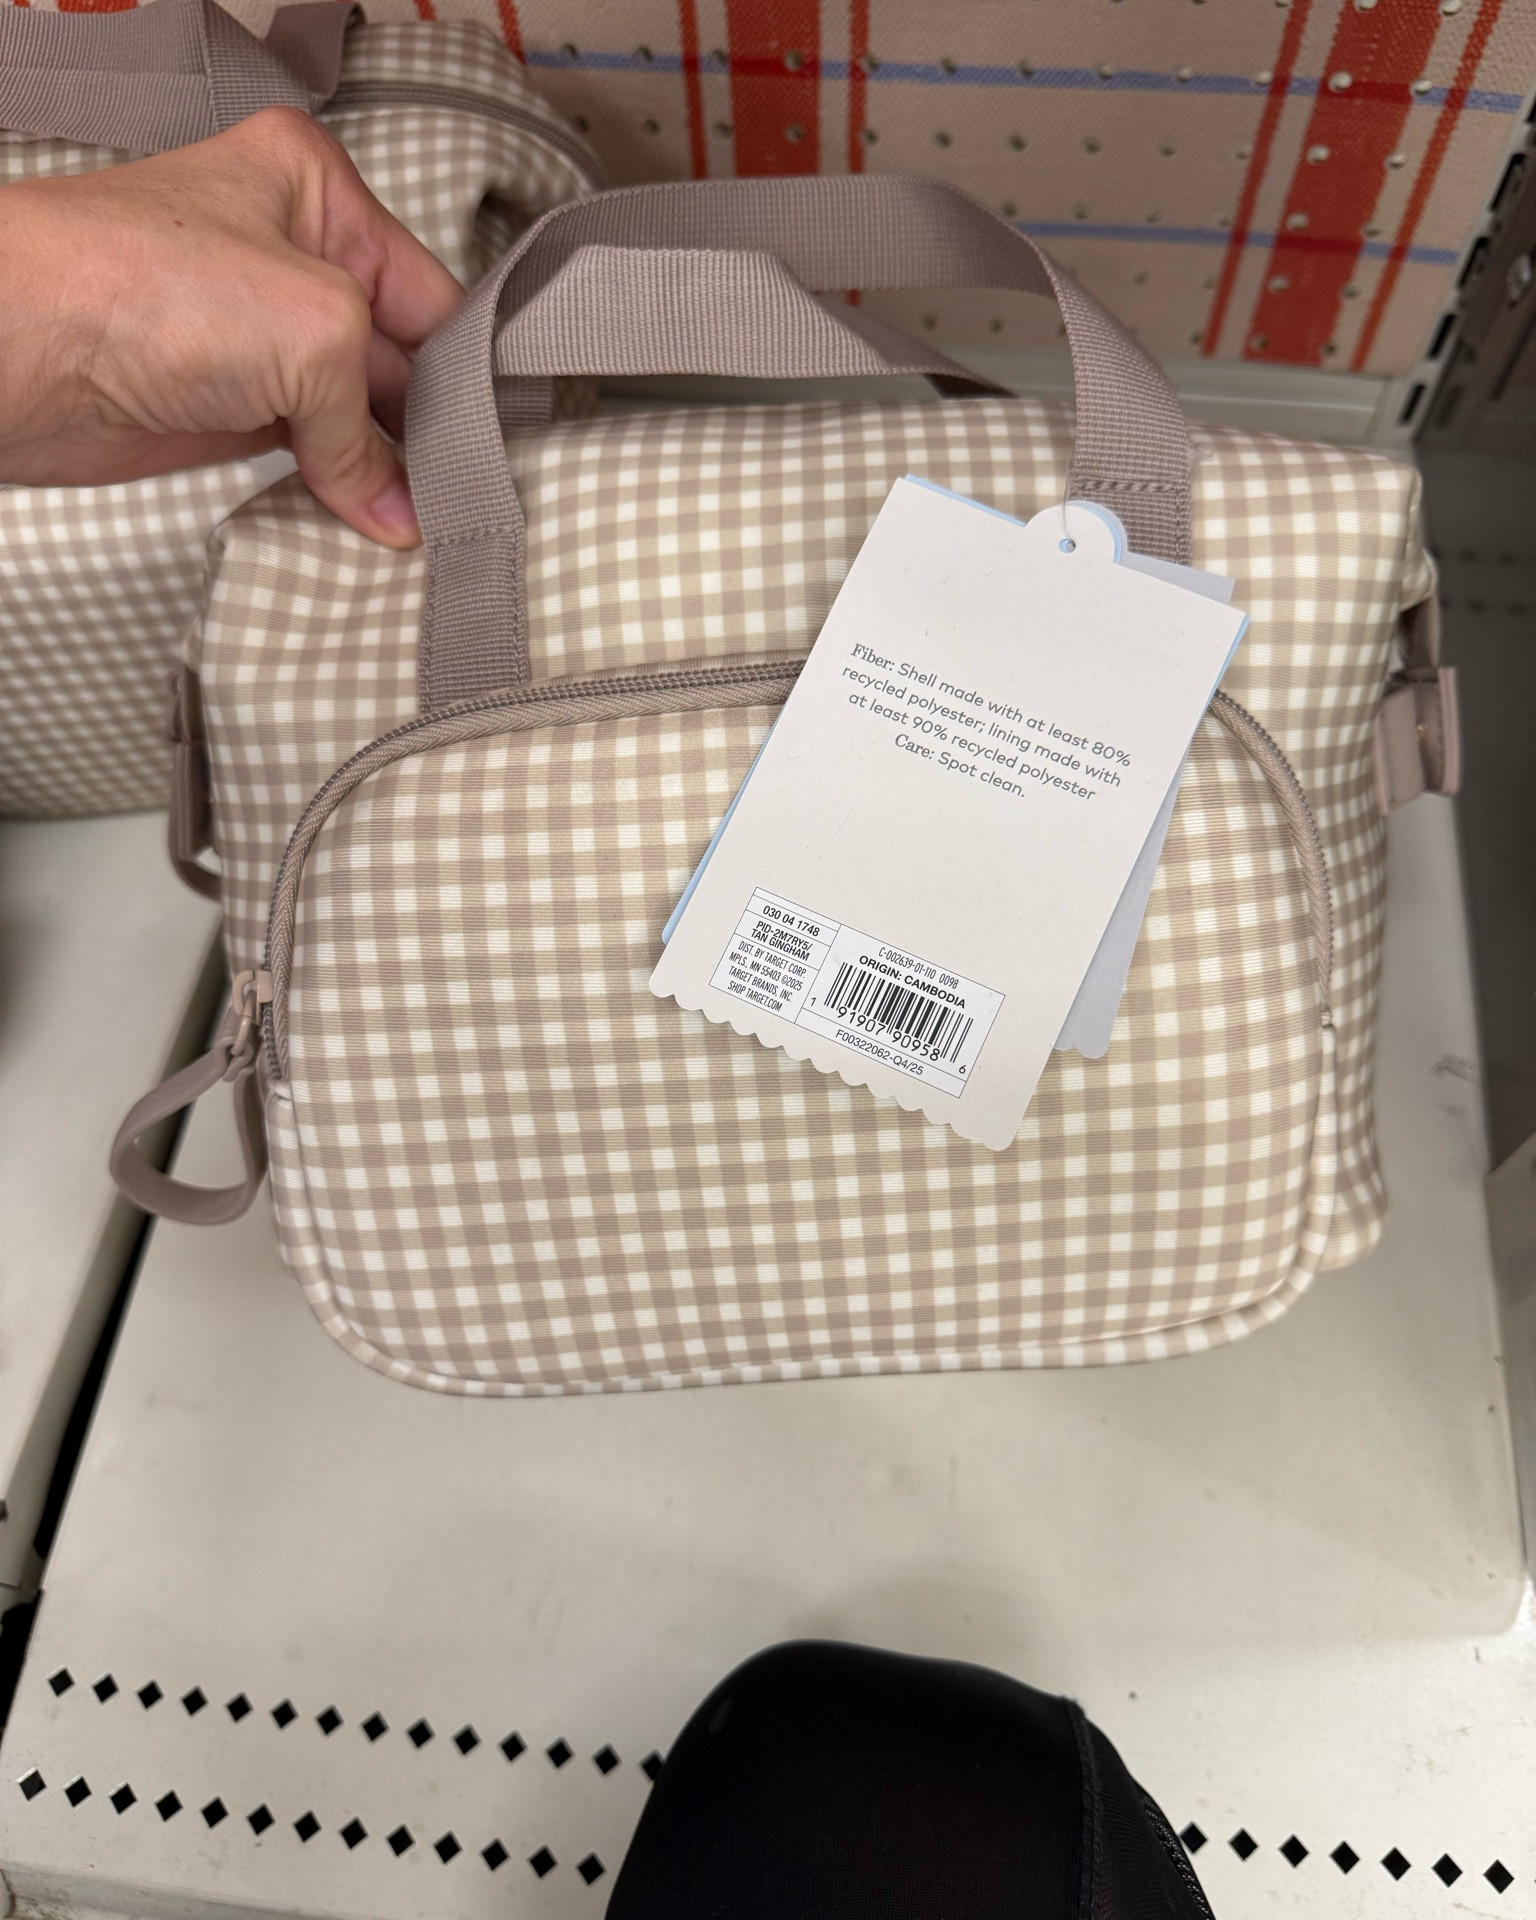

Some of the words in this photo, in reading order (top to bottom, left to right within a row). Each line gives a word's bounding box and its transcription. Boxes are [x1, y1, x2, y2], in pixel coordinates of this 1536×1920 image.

[842, 666, 906, 700] recycled
[906, 692, 986, 733] polyester;
[988, 722, 1031, 752] lining
[1035, 743, 1081, 770] made
[1085, 762, 1121, 787] with
[850, 643, 895, 671] Fiber:
[898, 662, 938, 688] Shell
[939, 681, 984, 707] made
[988, 699, 1023, 723] with
[1026, 715, 1045, 732] at
[1048, 723, 1088, 750] least
[1091, 741, 1131, 767] 80%
[849, 692, 867, 708] at
[869, 698, 909, 725] least
[912, 716, 947, 741] 90%
[951, 734, 1018, 769] recycled
[1018, 761, 1096, 800] polyester
[895, 733, 935, 760] Care:
[938, 751, 978, 778] Spot
[980, 771, 1025, 798] clean.
[756, 920, 813, 951] PID-2M7RY5/
[763, 905, 781, 920] 030
[782, 914, 795, 926] 04
[797, 920, 821, 937] 1748
[738, 940, 754, 955] DIST.
[754, 948, 765, 959] BY
[766, 952, 789, 970] TARGET
[788, 963, 807, 979] CORP.
[751, 928, 769, 943] TAN
[769, 937, 810, 961] GINGHAM
[727, 980, 746, 996] SHOP
[728, 965, 753, 982] TARGET
[780, 988, 793, 1003] INC.
[750, 960, 761, 973] MN
[761, 966, 782, 982] 55403
[859, 955, 903, 981] ORIGIN:
[904, 975, 966, 1009] CAMBODIA
[878, 947, 937, 980] C-002639-01-110
[938, 974, 960, 990] 0098
[810, 997, 817, 1007] 1
[838, 1006, 886, 1036] 91907
[892, 1030, 941, 1062] 90958
[958, 1064, 967, 1075] 6
[835, 1029, 924, 1075] F00322062-Q4/25
